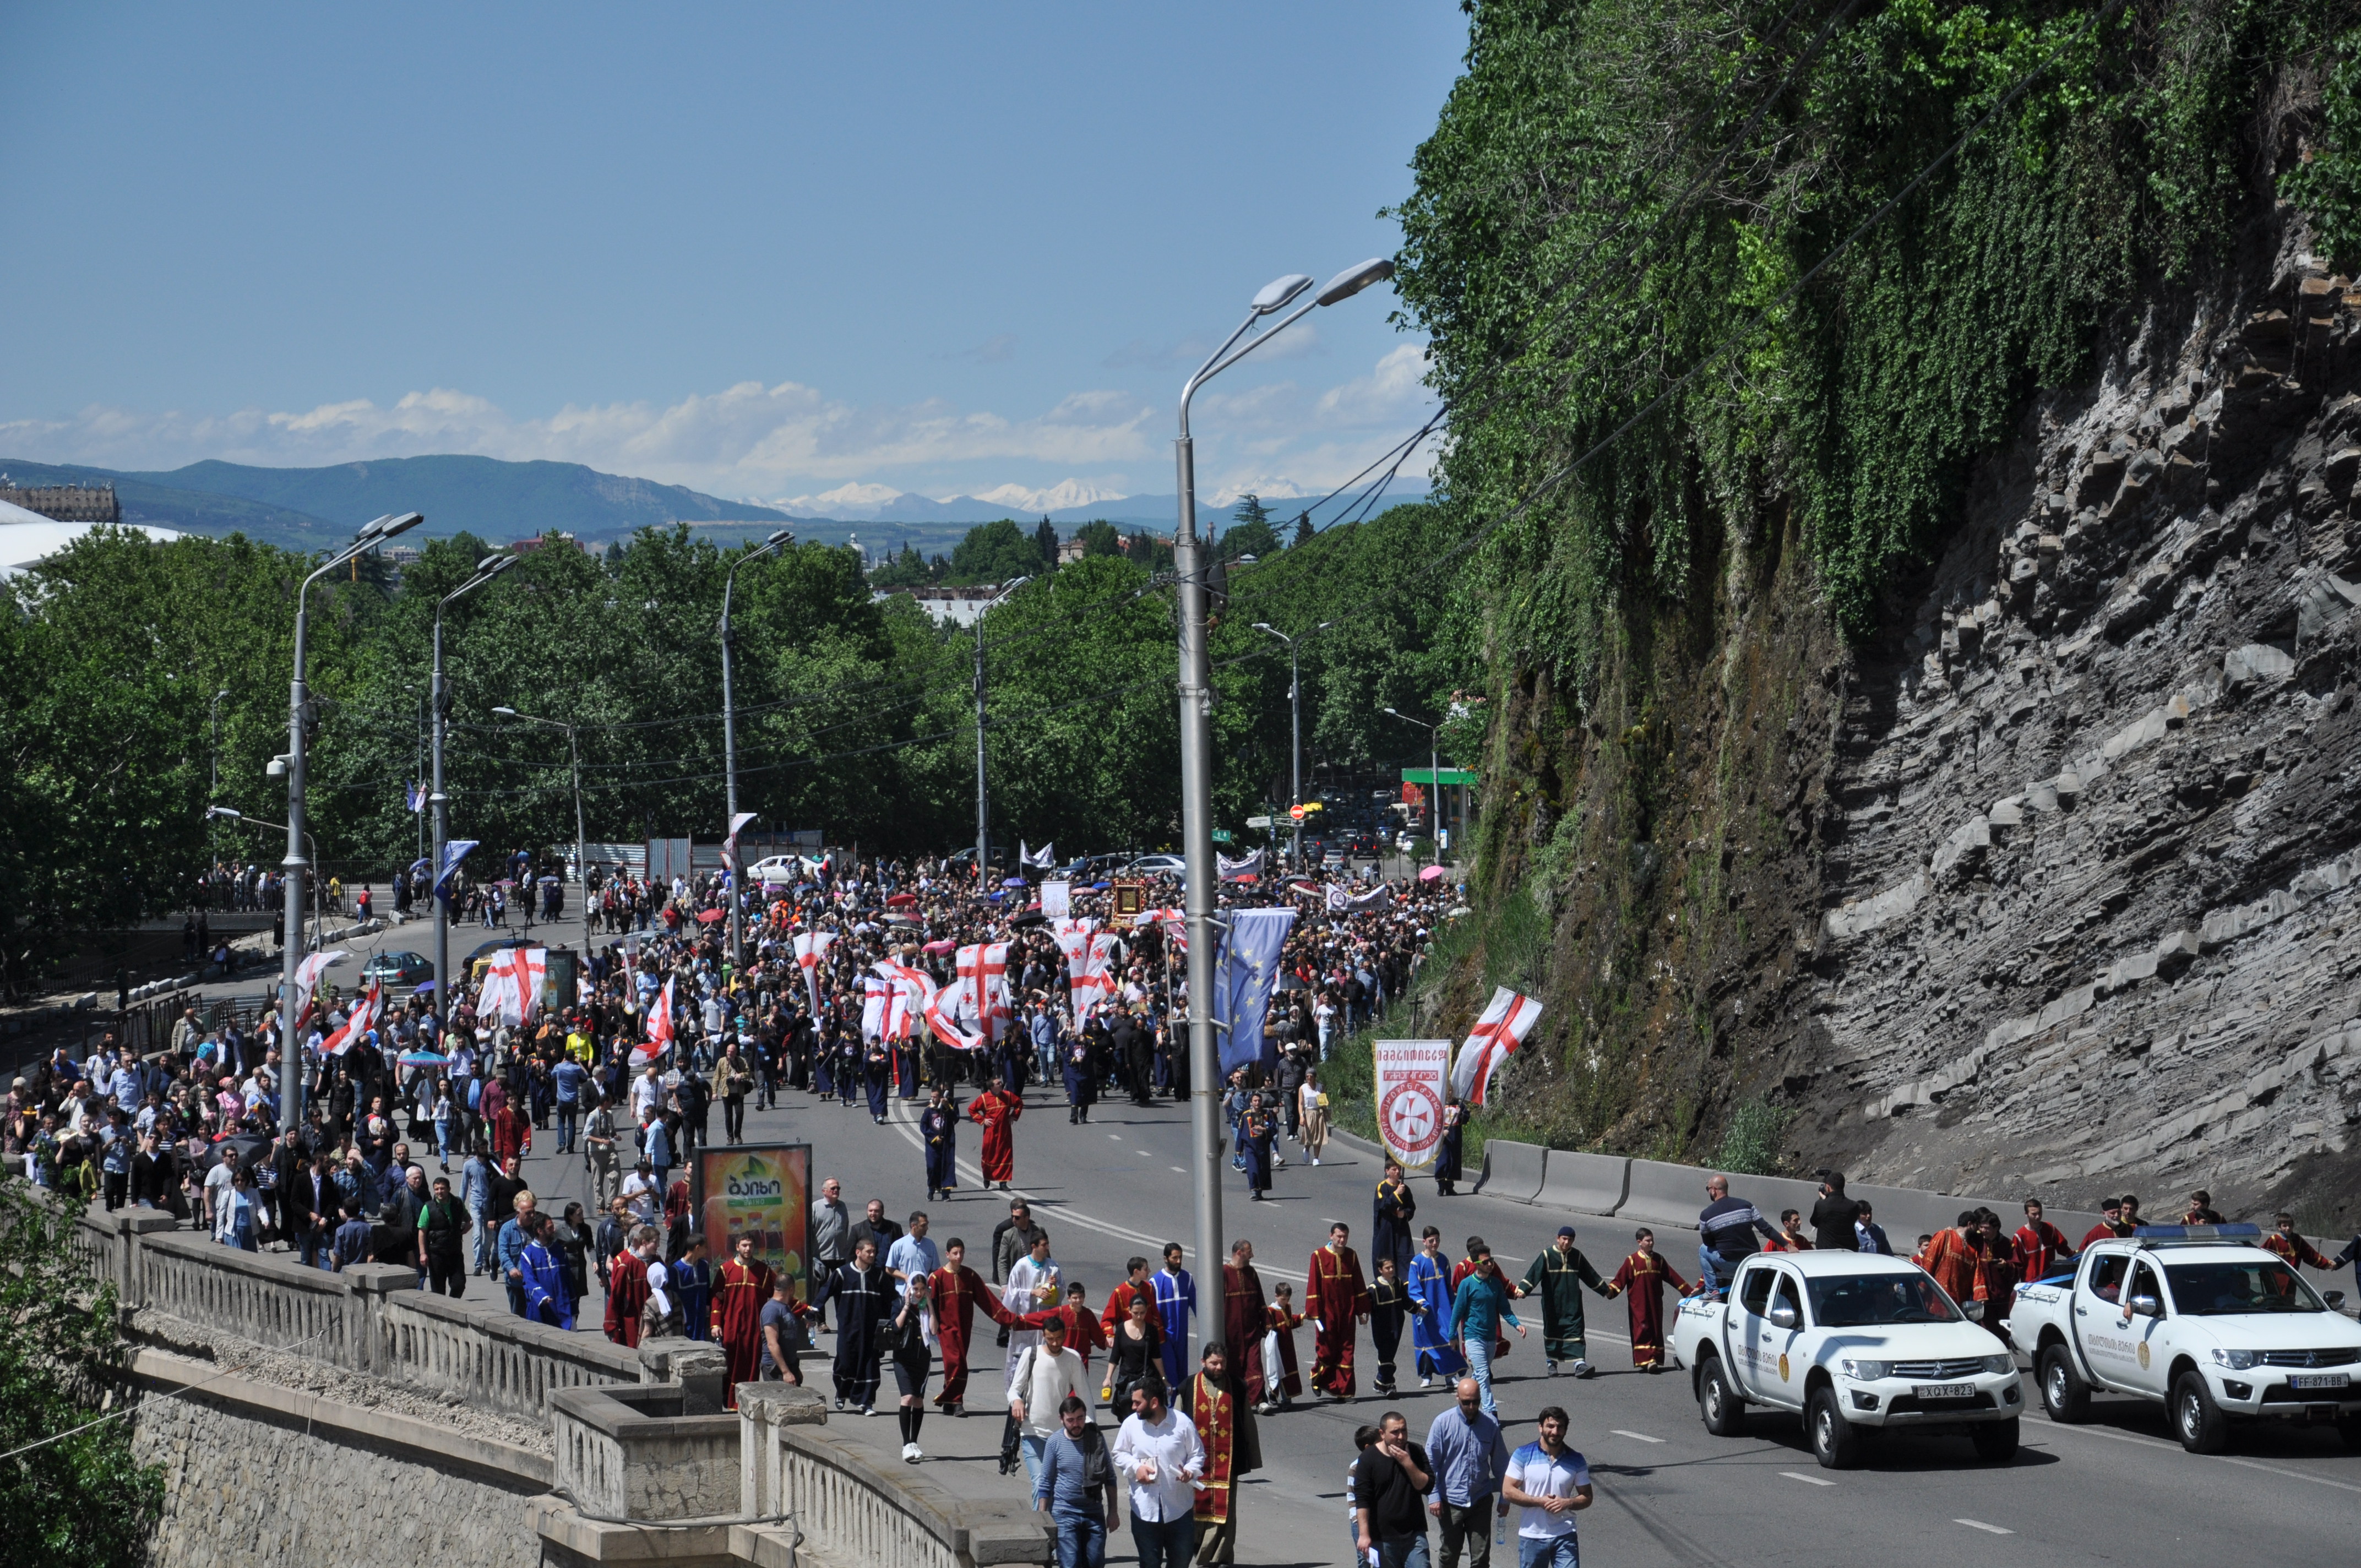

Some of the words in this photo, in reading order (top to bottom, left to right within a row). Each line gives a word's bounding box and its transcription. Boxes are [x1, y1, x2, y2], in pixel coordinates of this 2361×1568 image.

[728, 1174, 780, 1196] ბაიხო
[2088, 1333, 2117, 1350] თბილისის
[2118, 1340, 2135, 1354] მერია
[1738, 1344, 1762, 1362] თბილისის
[1762, 1352, 1777, 1366] მერია
[1926, 1386, 1973, 1397] XQX-823
[2299, 1376, 2342, 1387] FF-871-BB
